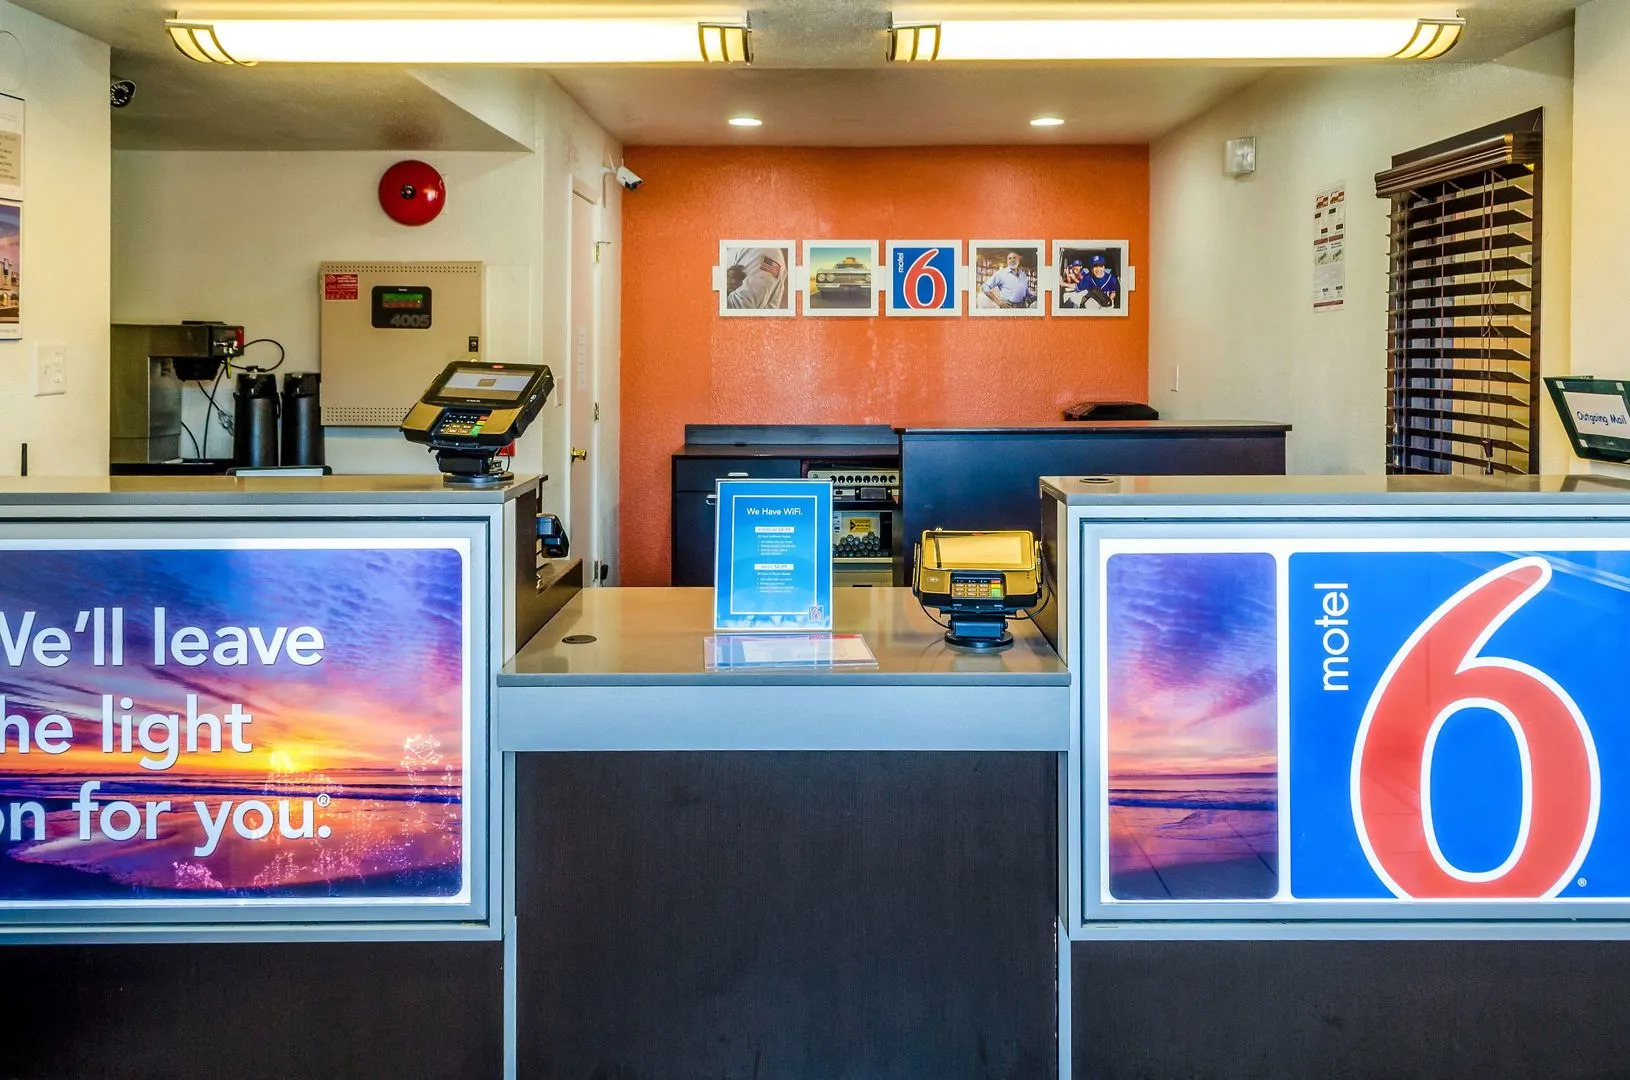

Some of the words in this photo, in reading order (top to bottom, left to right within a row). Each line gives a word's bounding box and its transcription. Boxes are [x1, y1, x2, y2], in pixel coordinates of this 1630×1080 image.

[903, 248, 947, 309] 6
[390, 314, 430, 327] 4005
[1577, 411, 1608, 425] Outgoing
[1610, 414, 1627, 424] Mail
[746, 507, 759, 515] We
[762, 507, 781, 515] Have
[154, 606, 326, 667] leave
[101, 694, 253, 771] light
[1313, 582, 1349, 693] motel
[1350, 556, 1602, 899] 6
[0, 799, 46, 841] n
[72, 781, 172, 841] for
